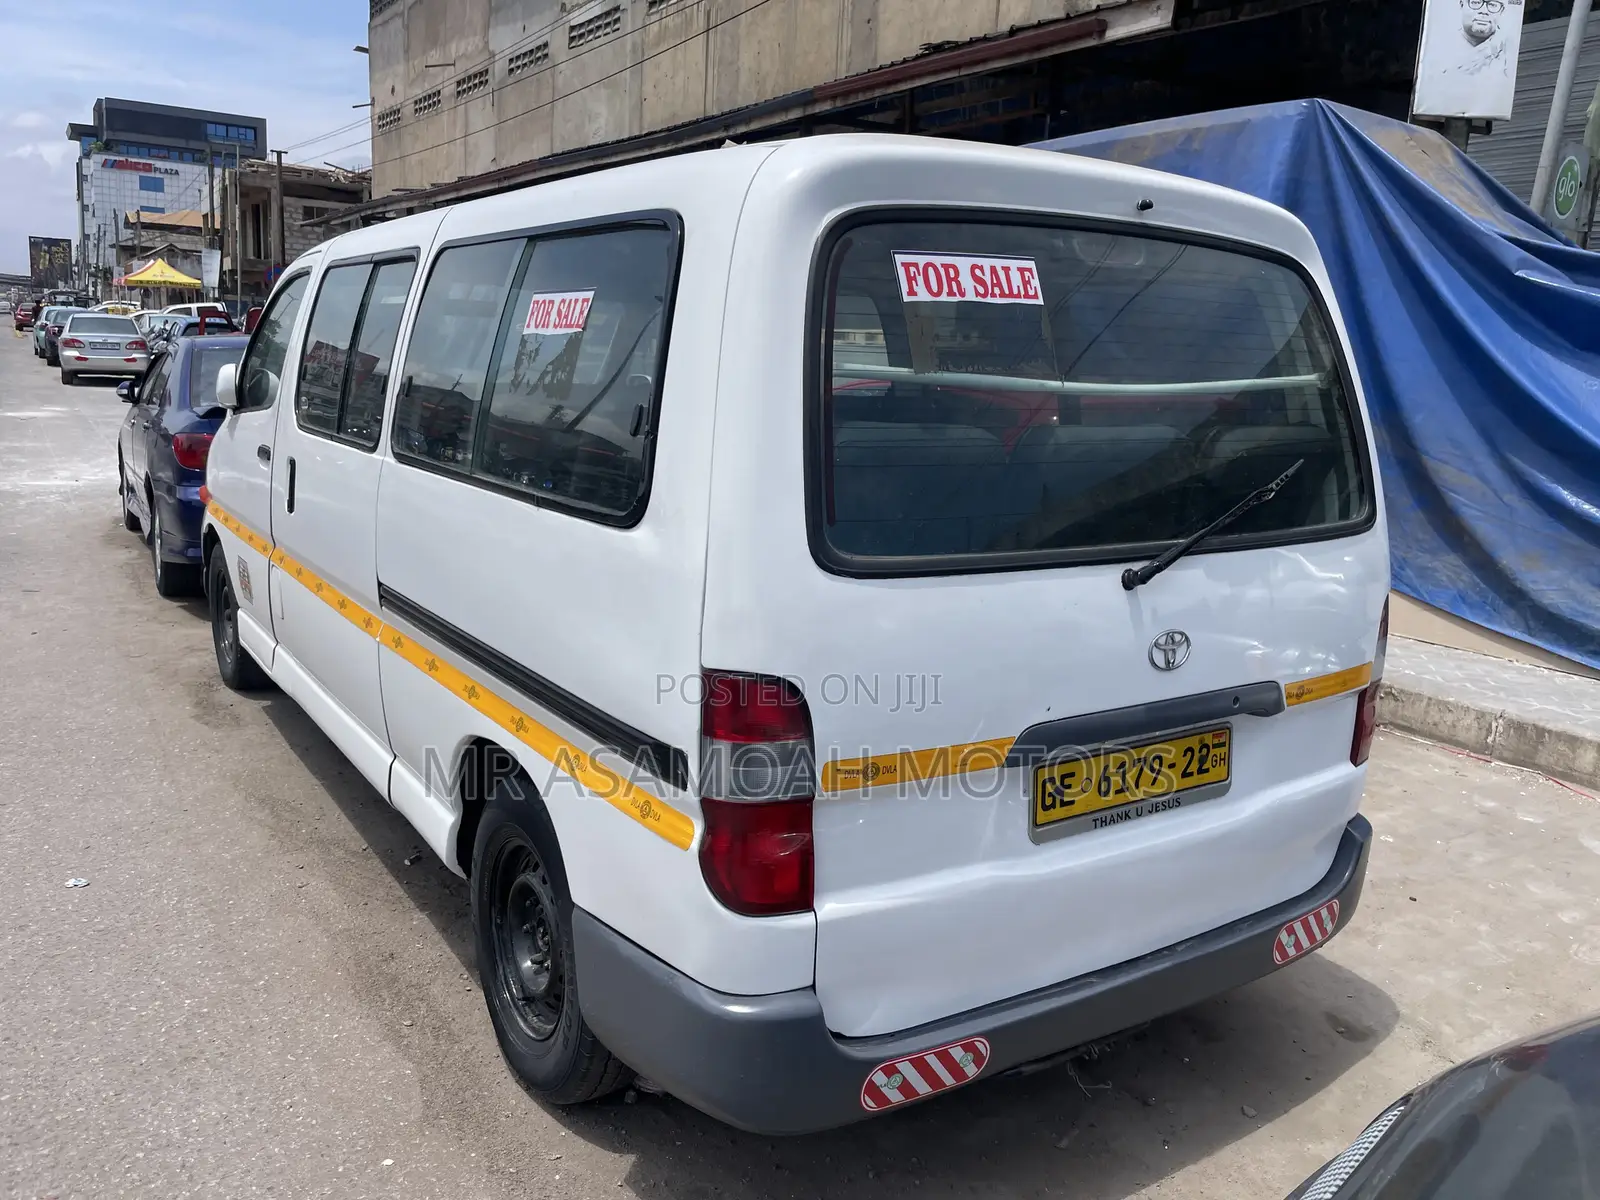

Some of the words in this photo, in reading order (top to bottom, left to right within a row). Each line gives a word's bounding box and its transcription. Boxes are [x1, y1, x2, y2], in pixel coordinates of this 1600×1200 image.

[153, 166, 180, 176] PLAZA
[1559, 171, 1576, 201] glo
[901, 261, 966, 298] FOR
[970, 263, 1040, 300] SALE
[526, 299, 555, 329] FOR
[553, 297, 591, 329] SALE
[881, 764, 898, 775] DVLA
[1211, 752, 1227, 769] GH
[1040, 772, 1076, 812] GE
[1097, 743, 1211, 798] 6179-22
[1092, 810, 1131, 829] THANK
[1136, 806, 1144, 817] U
[1148, 797, 1182, 814] JESUS
